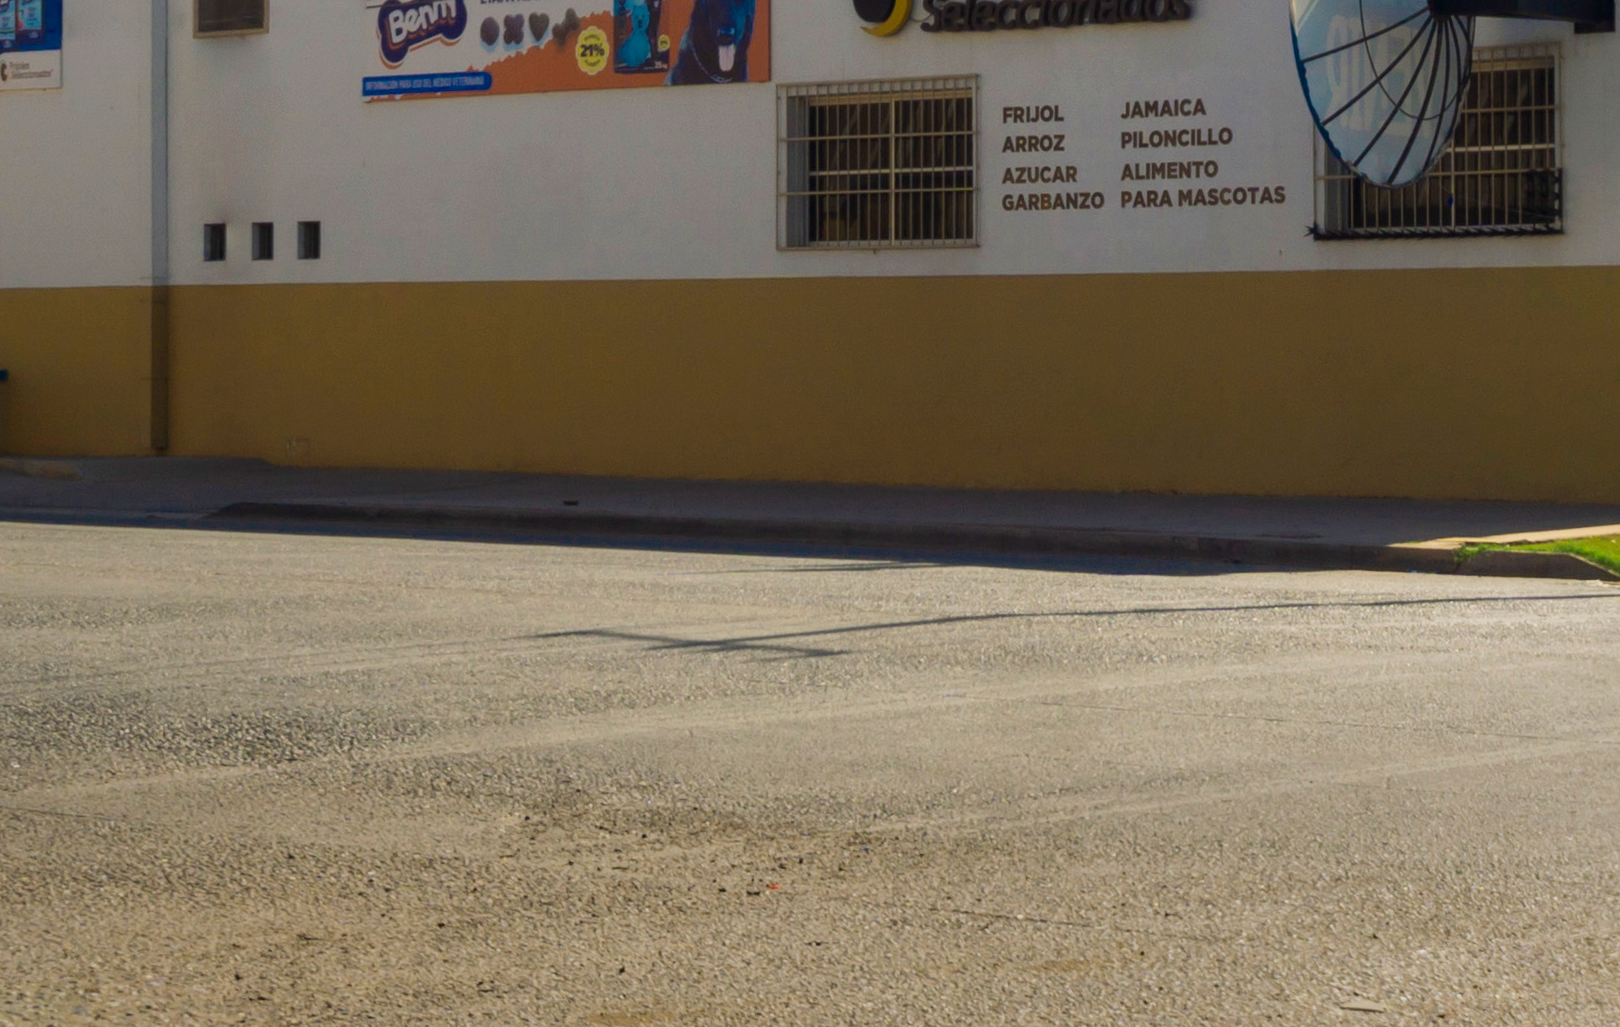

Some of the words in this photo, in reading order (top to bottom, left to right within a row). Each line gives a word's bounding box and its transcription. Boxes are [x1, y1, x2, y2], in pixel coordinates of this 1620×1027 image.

[580, 42, 605, 57] 21%
[1002, 104, 1065, 124] FRIJOL
[1120, 98, 1207, 120] JAMAICA
[1001, 134, 1066, 153] ARROZ
[1120, 127, 1234, 149] PILONCILLO
[1001, 165, 1078, 184] AZUCAR
[1120, 160, 1219, 181] ALIMENTO
[1001, 191, 1105, 211] GARBANZO
[1120, 190, 1174, 208] PARA
[1177, 185, 1287, 207] MASCOTAS
